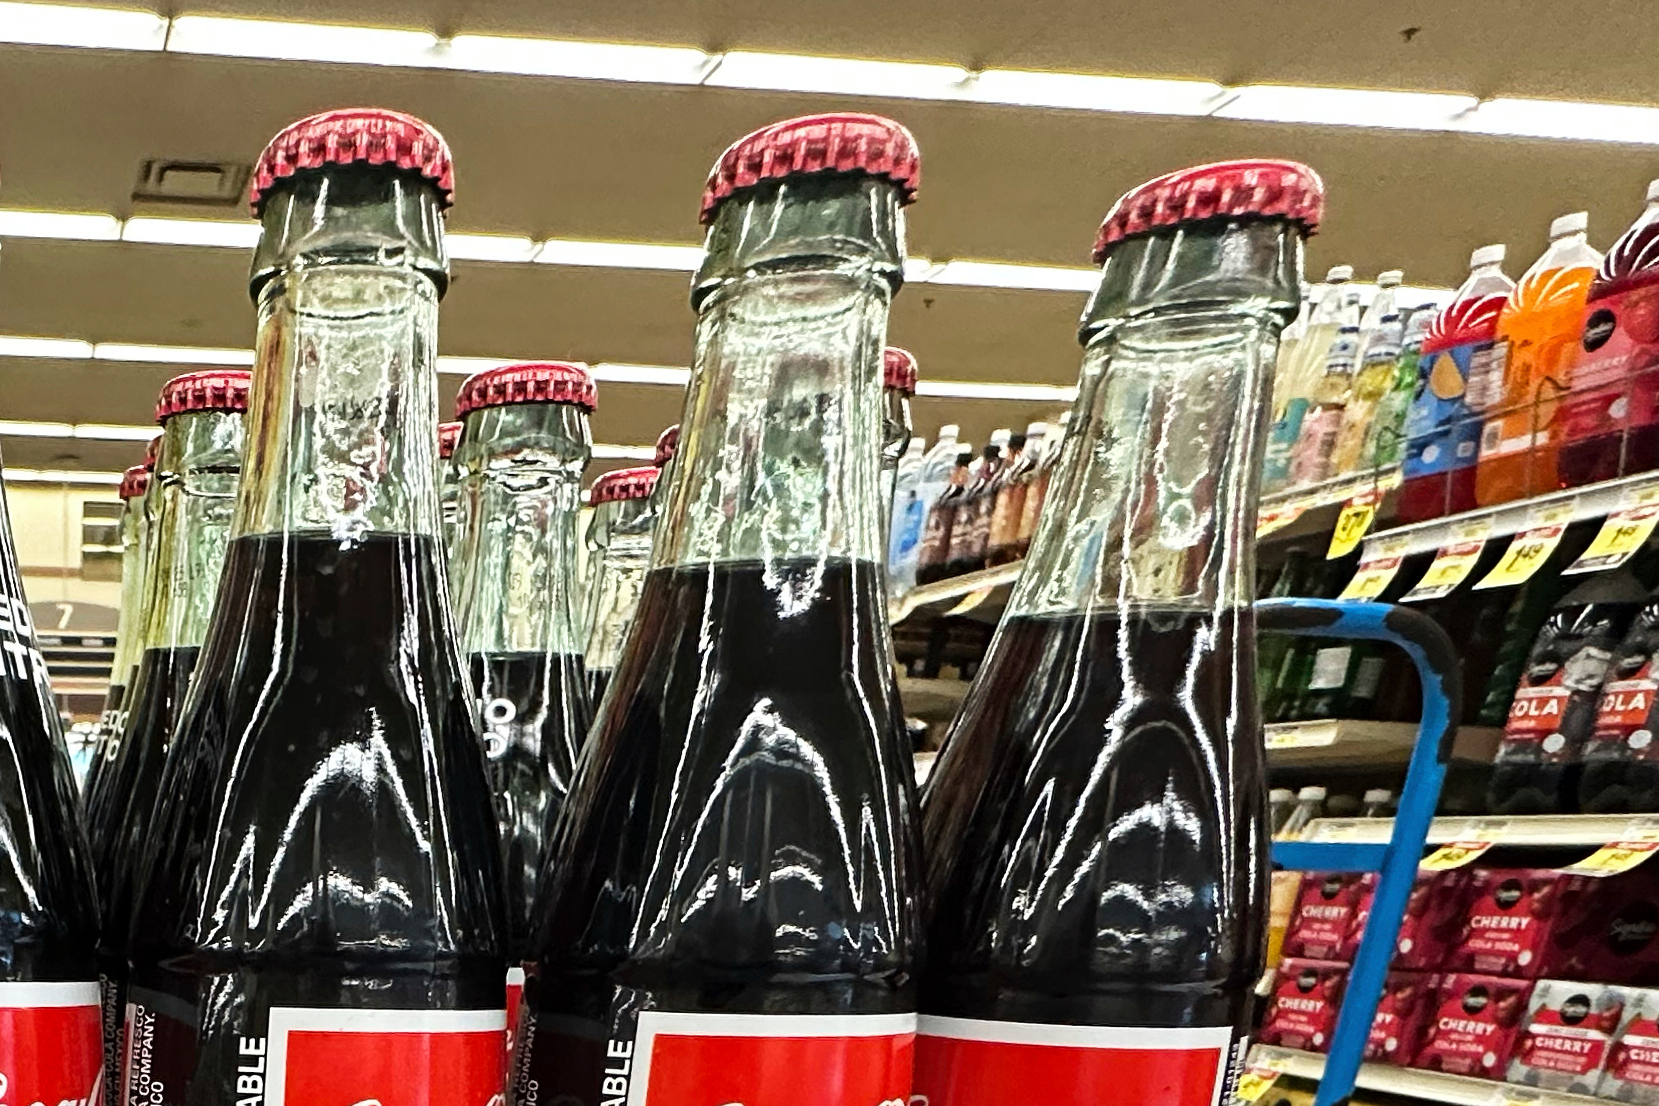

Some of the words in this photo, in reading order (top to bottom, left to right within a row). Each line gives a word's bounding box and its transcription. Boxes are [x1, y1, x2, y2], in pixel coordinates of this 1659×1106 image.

[55, 603, 74, 630] 7
[1302, 904, 1347, 920] CHERRY
[1470, 914, 1530, 931] CHERRY
[1277, 997, 1325, 1012] CHERRY
[1438, 1017, 1496, 1036] CHERRY
[139, 1011, 157, 1097] COMPANY.
[1535, 1036, 1592, 1055] CHERRY
